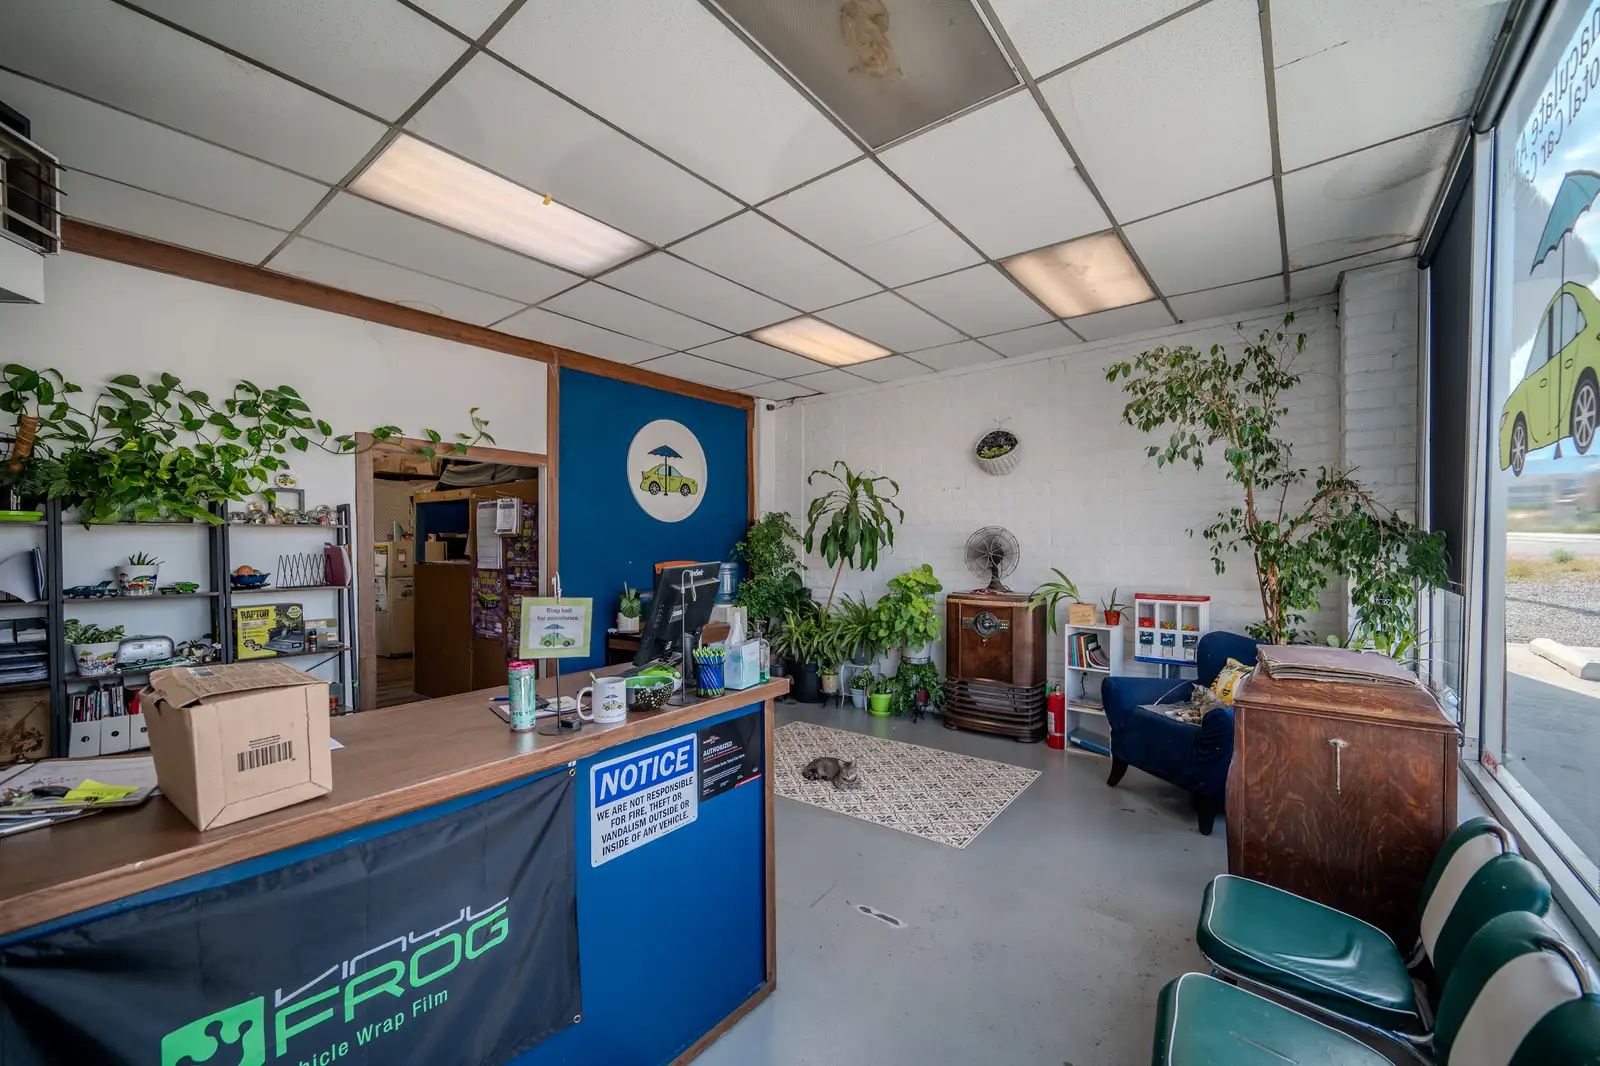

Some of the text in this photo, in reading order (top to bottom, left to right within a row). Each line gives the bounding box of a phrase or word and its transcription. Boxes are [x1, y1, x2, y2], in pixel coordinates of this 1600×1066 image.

[240, 609, 269, 620] RAPTOR
[600, 745, 690, 800] NOTICE
[596, 810, 610, 822] WE
[612, 802, 627, 816] ARE
[629, 794, 645, 810] NOT
[646, 776, 693, 802] RESPONSIBLE
[601, 817, 647, 844] VANDALISM
[648, 804, 679, 823] OUTSIDE
[680, 799, 690, 811] OR
[610, 792, 682, 828] FOR FIRE, THEFT OR
[602, 837, 629, 856] INSIDE
[631, 831, 642, 843] OF
[643, 822, 658, 838] ANY
[659, 811, 689, 830] VEHICLE.
[275, 906, 509, 1058] FROG
[356, 1012, 405, 1046] Wrap
[412, 990, 448, 1018] Film
